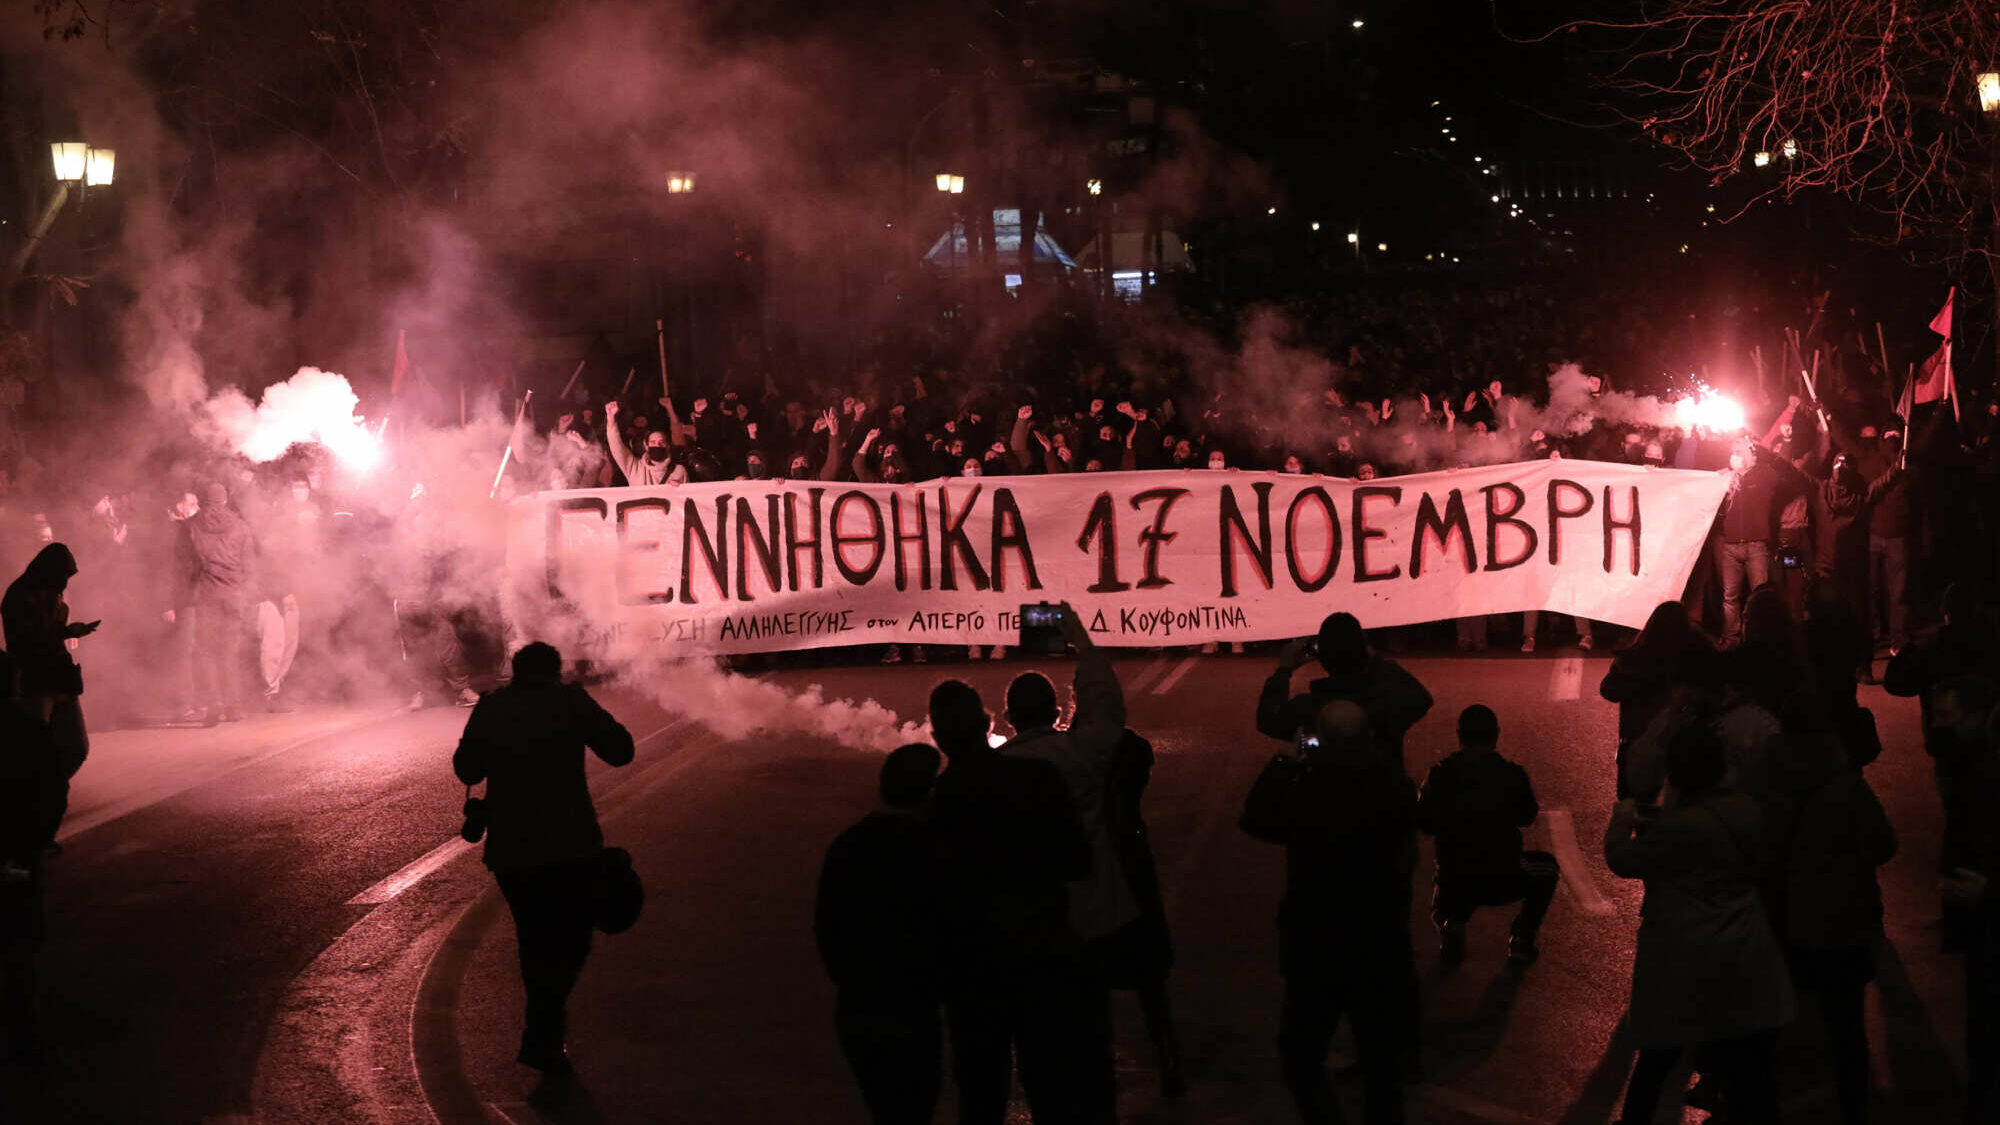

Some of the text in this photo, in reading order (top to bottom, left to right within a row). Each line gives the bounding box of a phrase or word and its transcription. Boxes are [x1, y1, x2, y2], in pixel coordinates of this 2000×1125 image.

[546, 479, 1642, 606] ΓΕΝΝΗΘΗΚΑ 17 ΝΟΕΜΒΡΗ
[720, 610, 855, 641] ΑΛΛΗΛΕΓΓΥΗΣ
[867, 618, 898, 629] στον
[908, 610, 984, 632] ΑΠΕΡΓΟ
